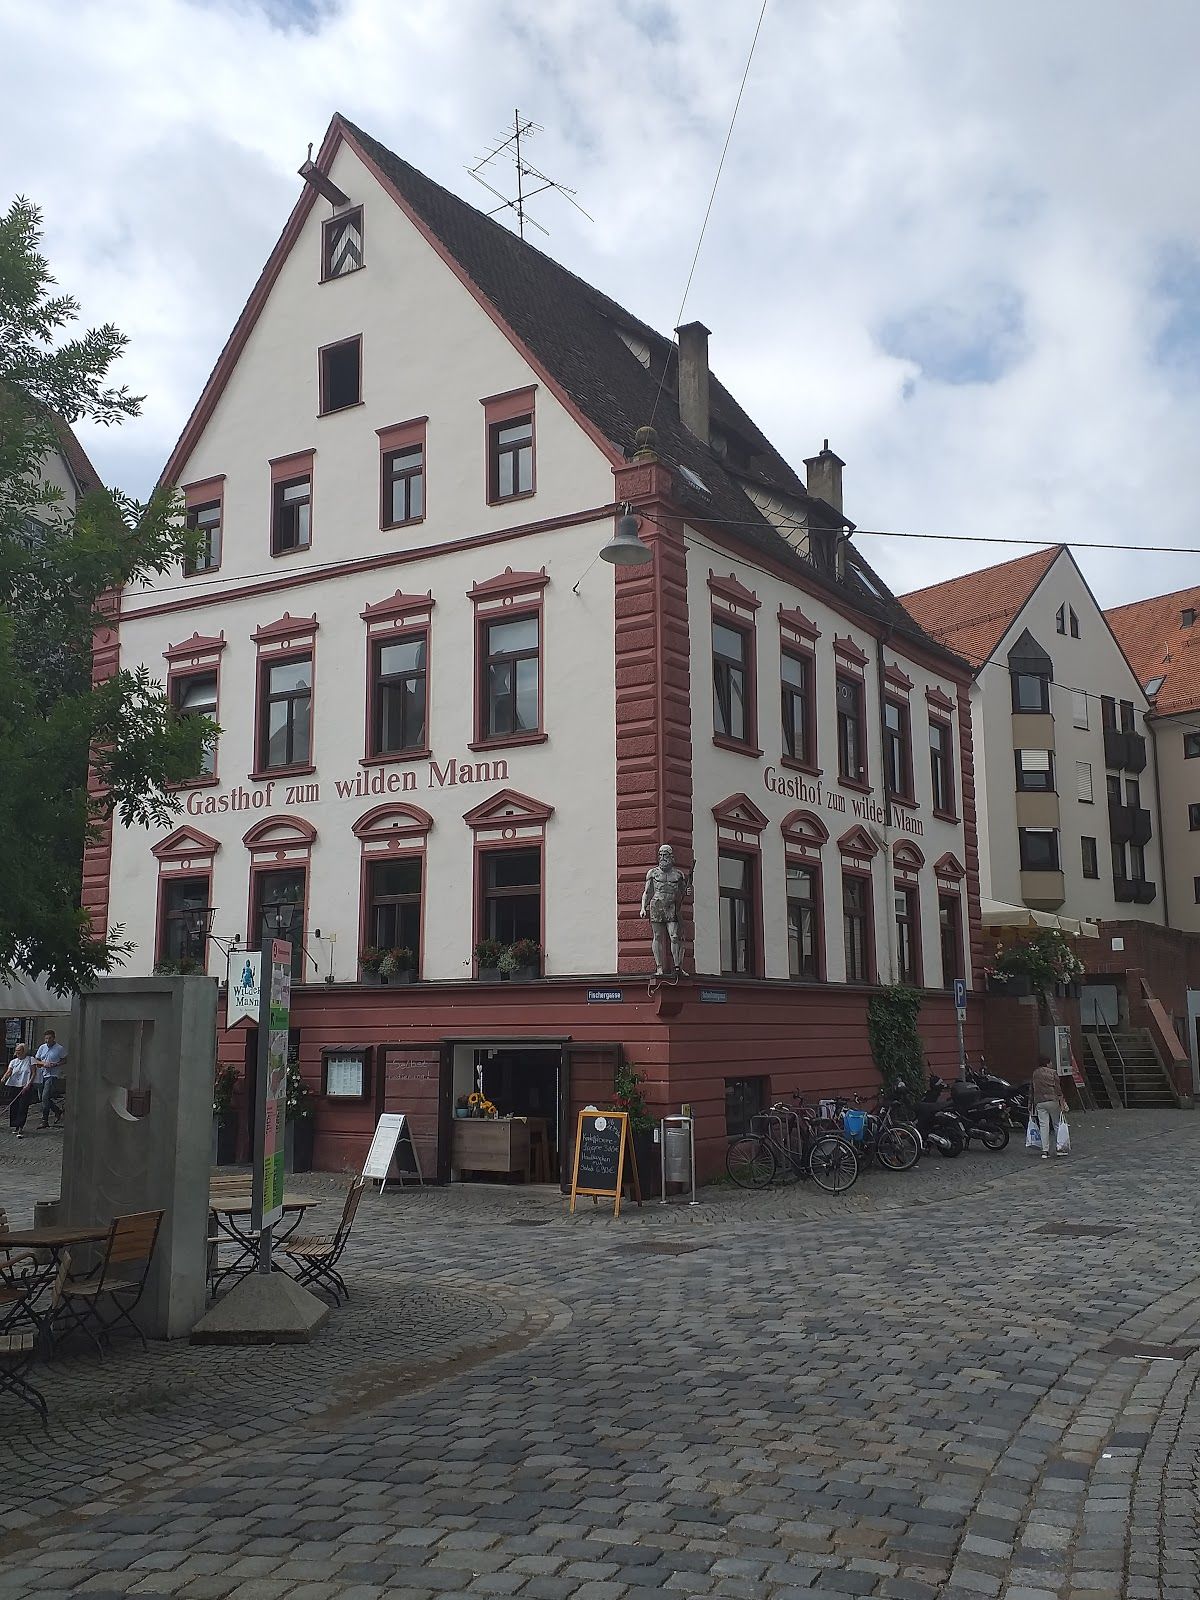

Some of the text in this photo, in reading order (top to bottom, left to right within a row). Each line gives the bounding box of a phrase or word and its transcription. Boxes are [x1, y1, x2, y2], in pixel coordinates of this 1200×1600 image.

[187, 758, 510, 816] Gasthof zum wilden Mann
[764, 766, 823, 806] Gasthof
[827, 791, 846, 813] zum
[892, 806, 924, 836] Mann
[588, 991, 621, 1000] Fischergasse
[957, 983, 963, 1004] P
